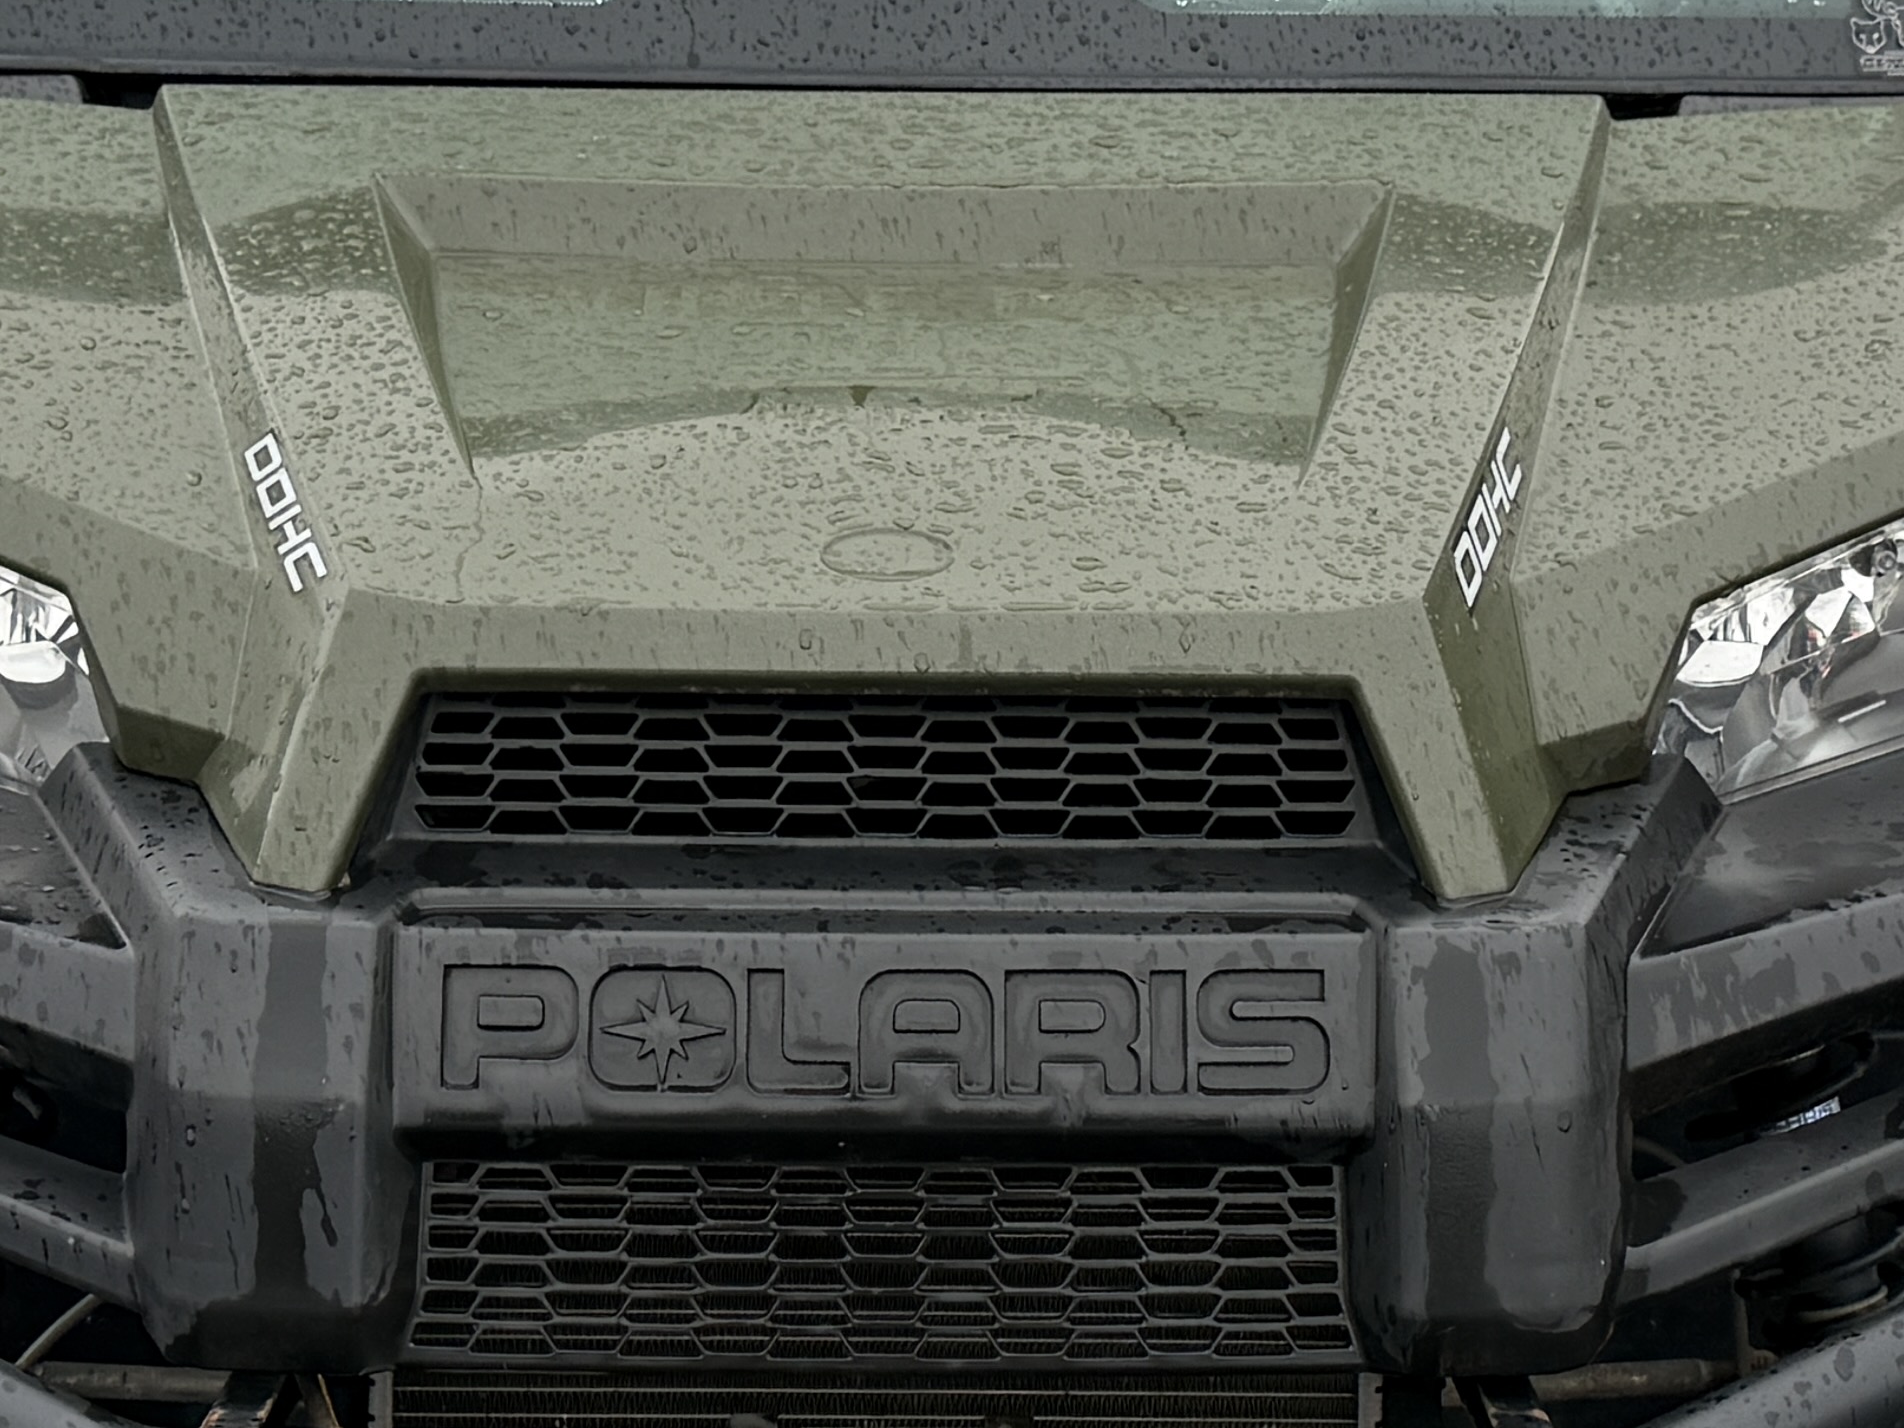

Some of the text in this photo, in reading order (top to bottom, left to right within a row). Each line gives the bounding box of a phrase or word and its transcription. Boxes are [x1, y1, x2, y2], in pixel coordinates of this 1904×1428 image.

[244, 432, 328, 593] DOHC
[1454, 426, 1523, 607] DOHC
[439, 963, 1333, 1100] POLARIS
